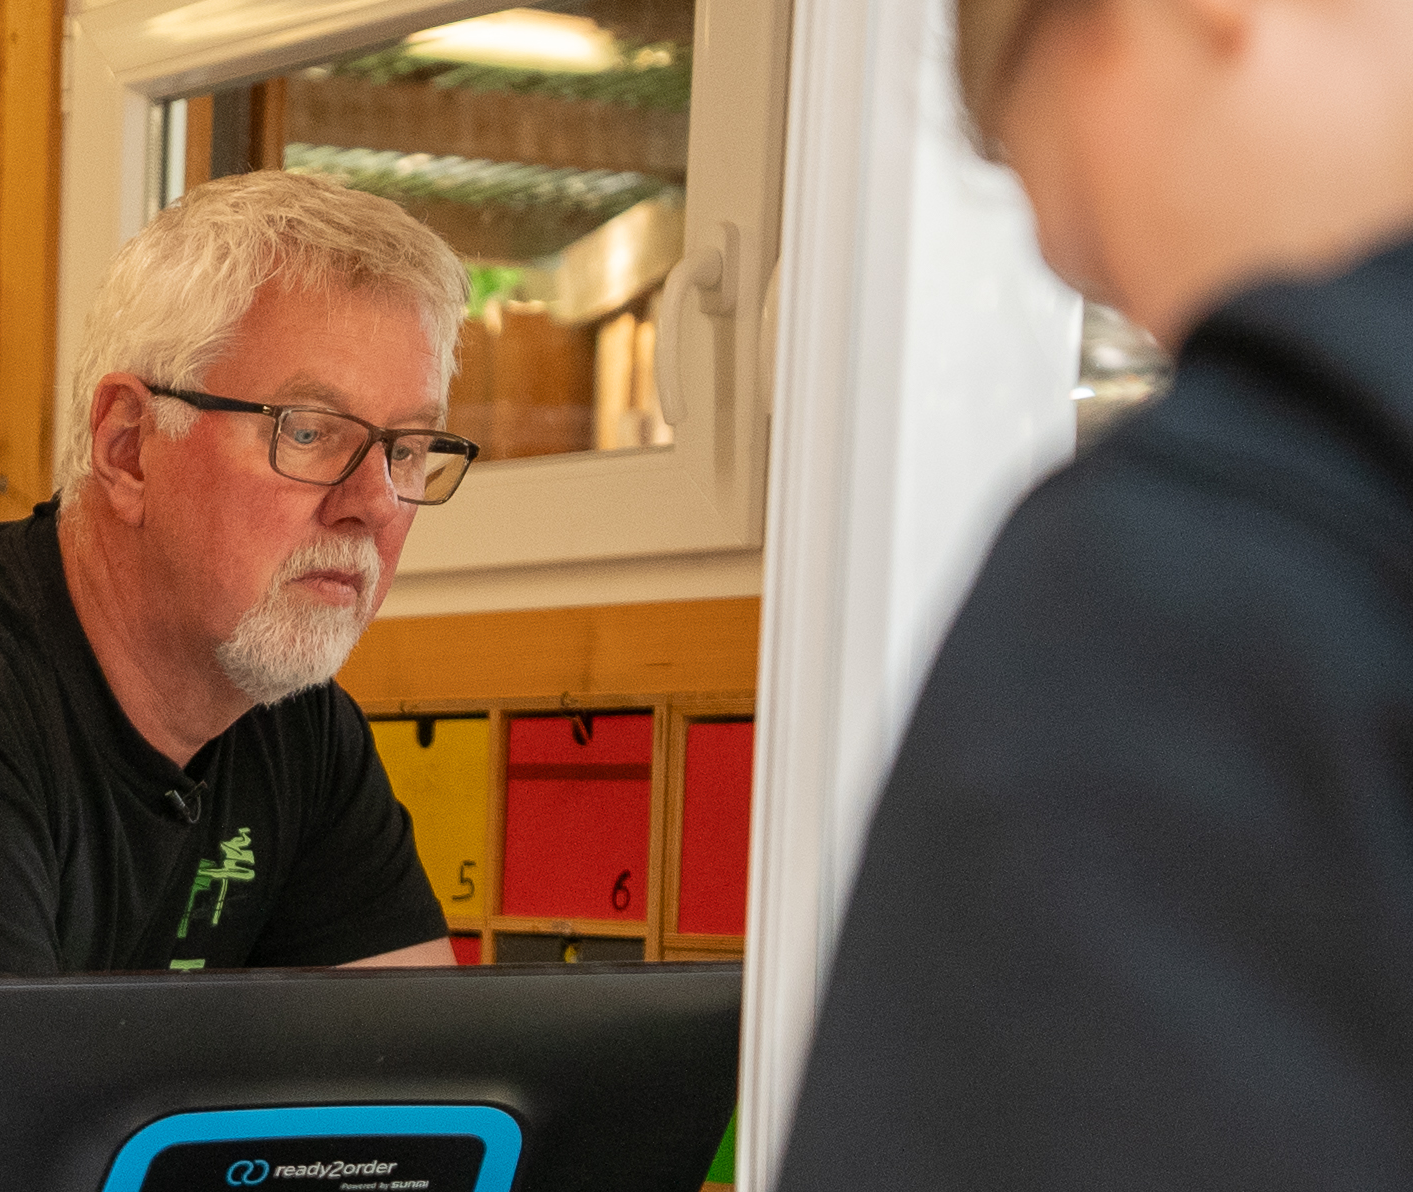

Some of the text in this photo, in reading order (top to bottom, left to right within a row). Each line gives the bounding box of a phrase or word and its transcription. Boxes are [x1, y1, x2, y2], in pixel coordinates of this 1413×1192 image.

[452, 860, 476, 901] 5
[612, 870, 631, 911] 6
[274, 1160, 398, 1178] ready2order
